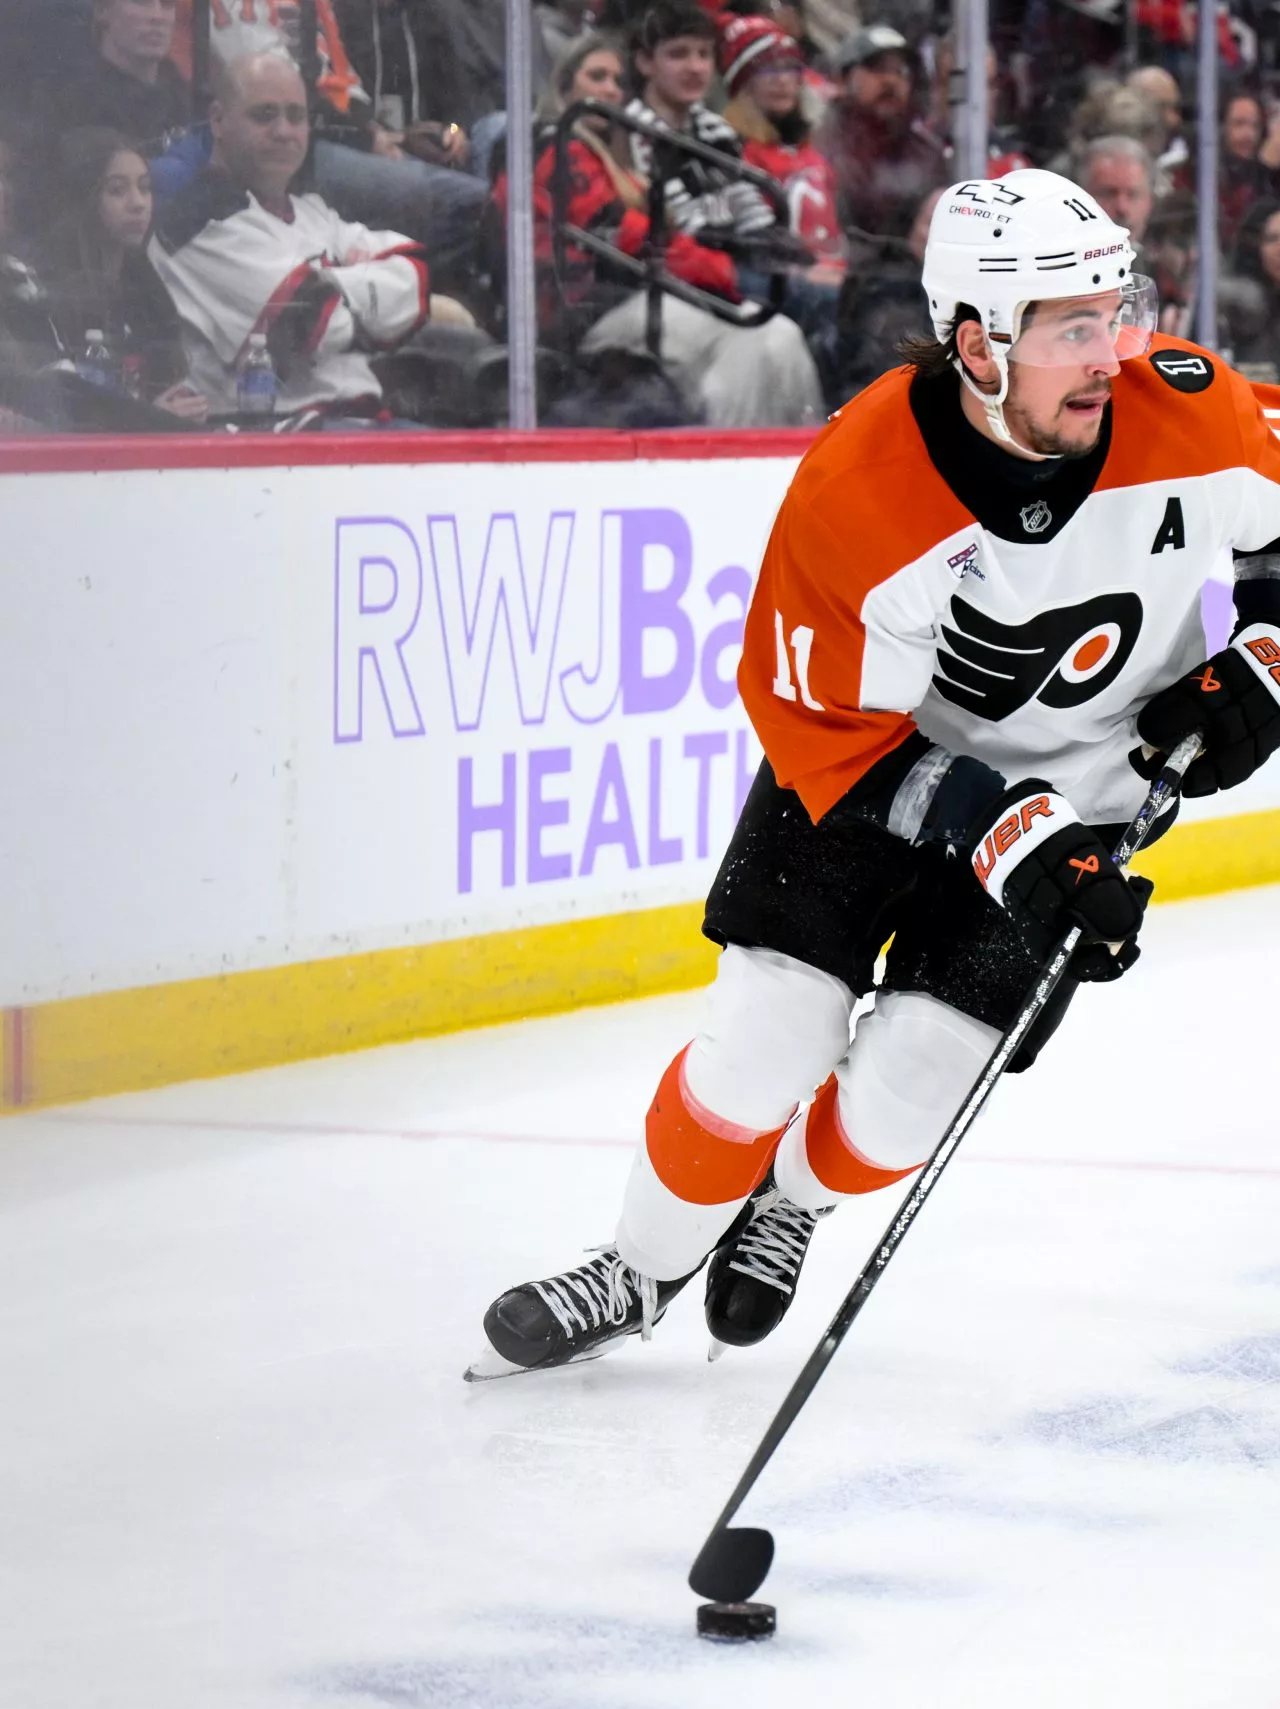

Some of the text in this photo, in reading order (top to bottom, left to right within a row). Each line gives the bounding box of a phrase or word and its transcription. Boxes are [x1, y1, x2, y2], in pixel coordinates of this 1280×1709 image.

[949, 205, 1012, 224] CHEVROET
[1063, 198, 1097, 221] 11
[1150, 496, 1186, 555] A
[772, 607, 826, 712] 11
[973, 795, 1055, 894] UER
